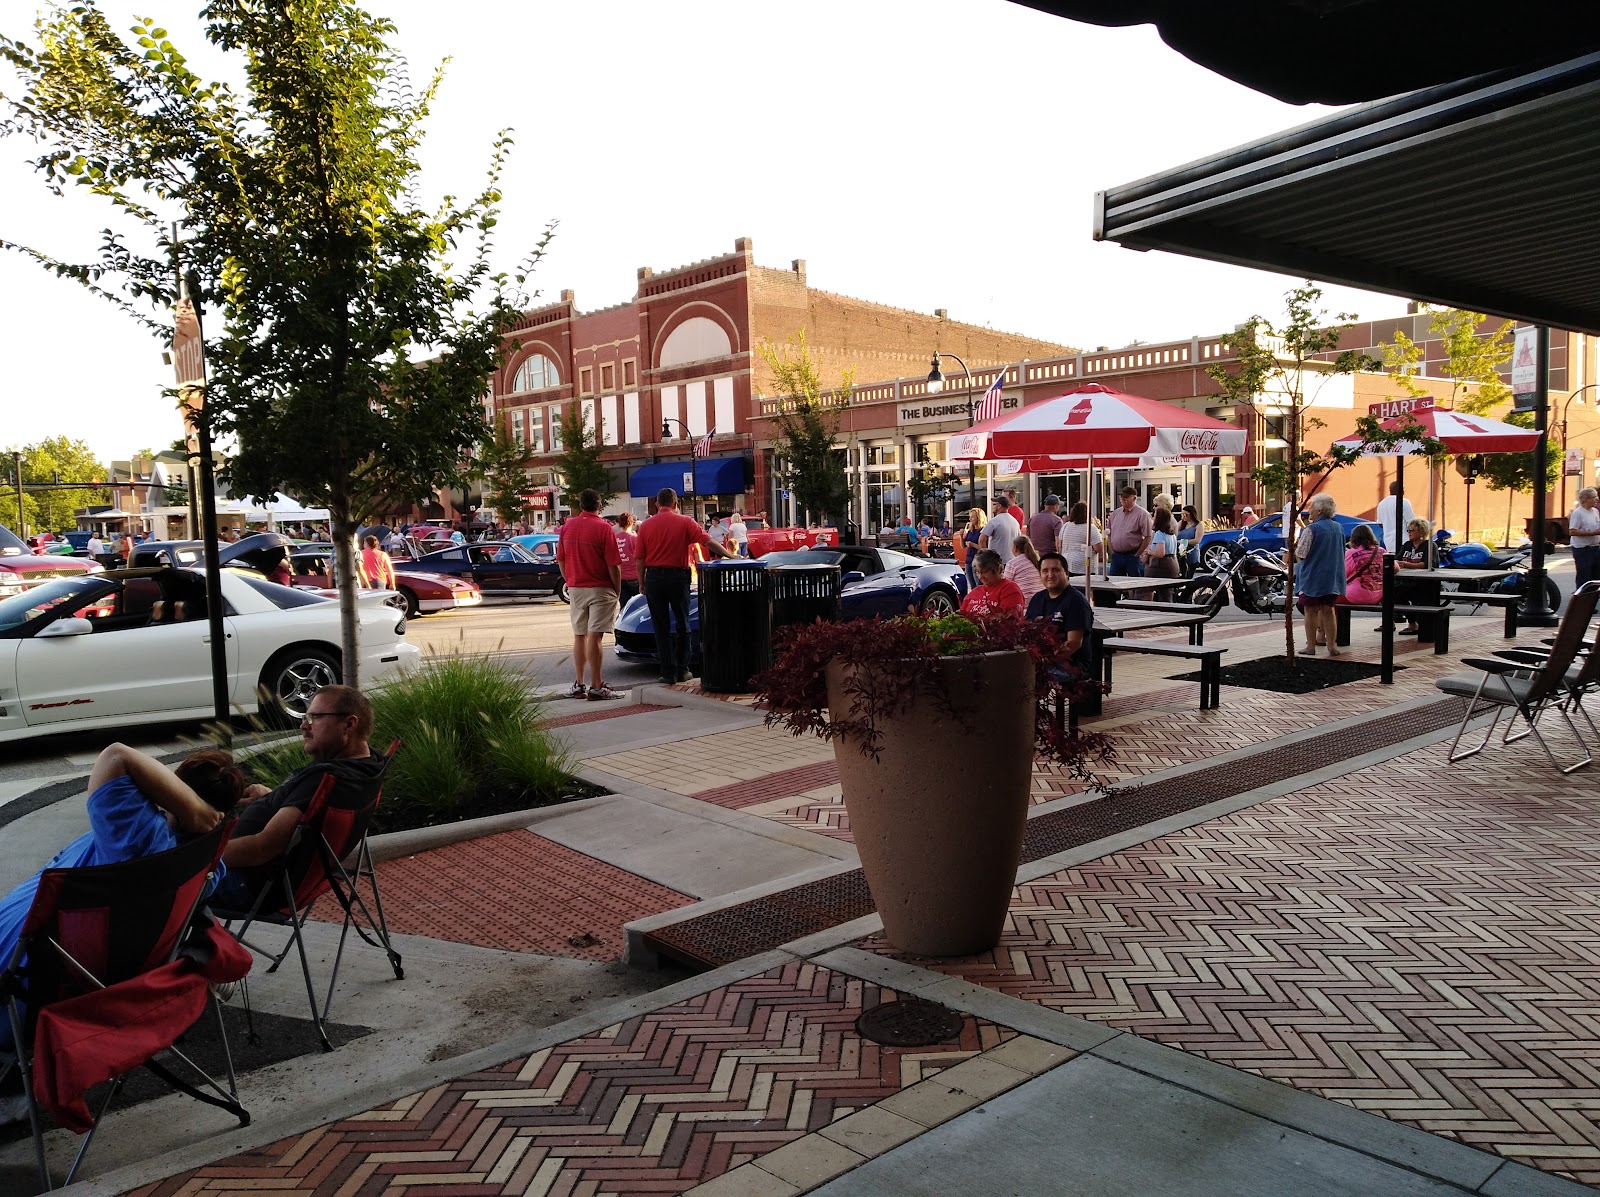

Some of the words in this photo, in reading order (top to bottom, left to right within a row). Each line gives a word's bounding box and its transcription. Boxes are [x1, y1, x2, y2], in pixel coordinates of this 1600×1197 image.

[175, 336, 201, 384] STOP
[901, 408, 920, 419] THE
[1380, 399, 1417, 417] HART
